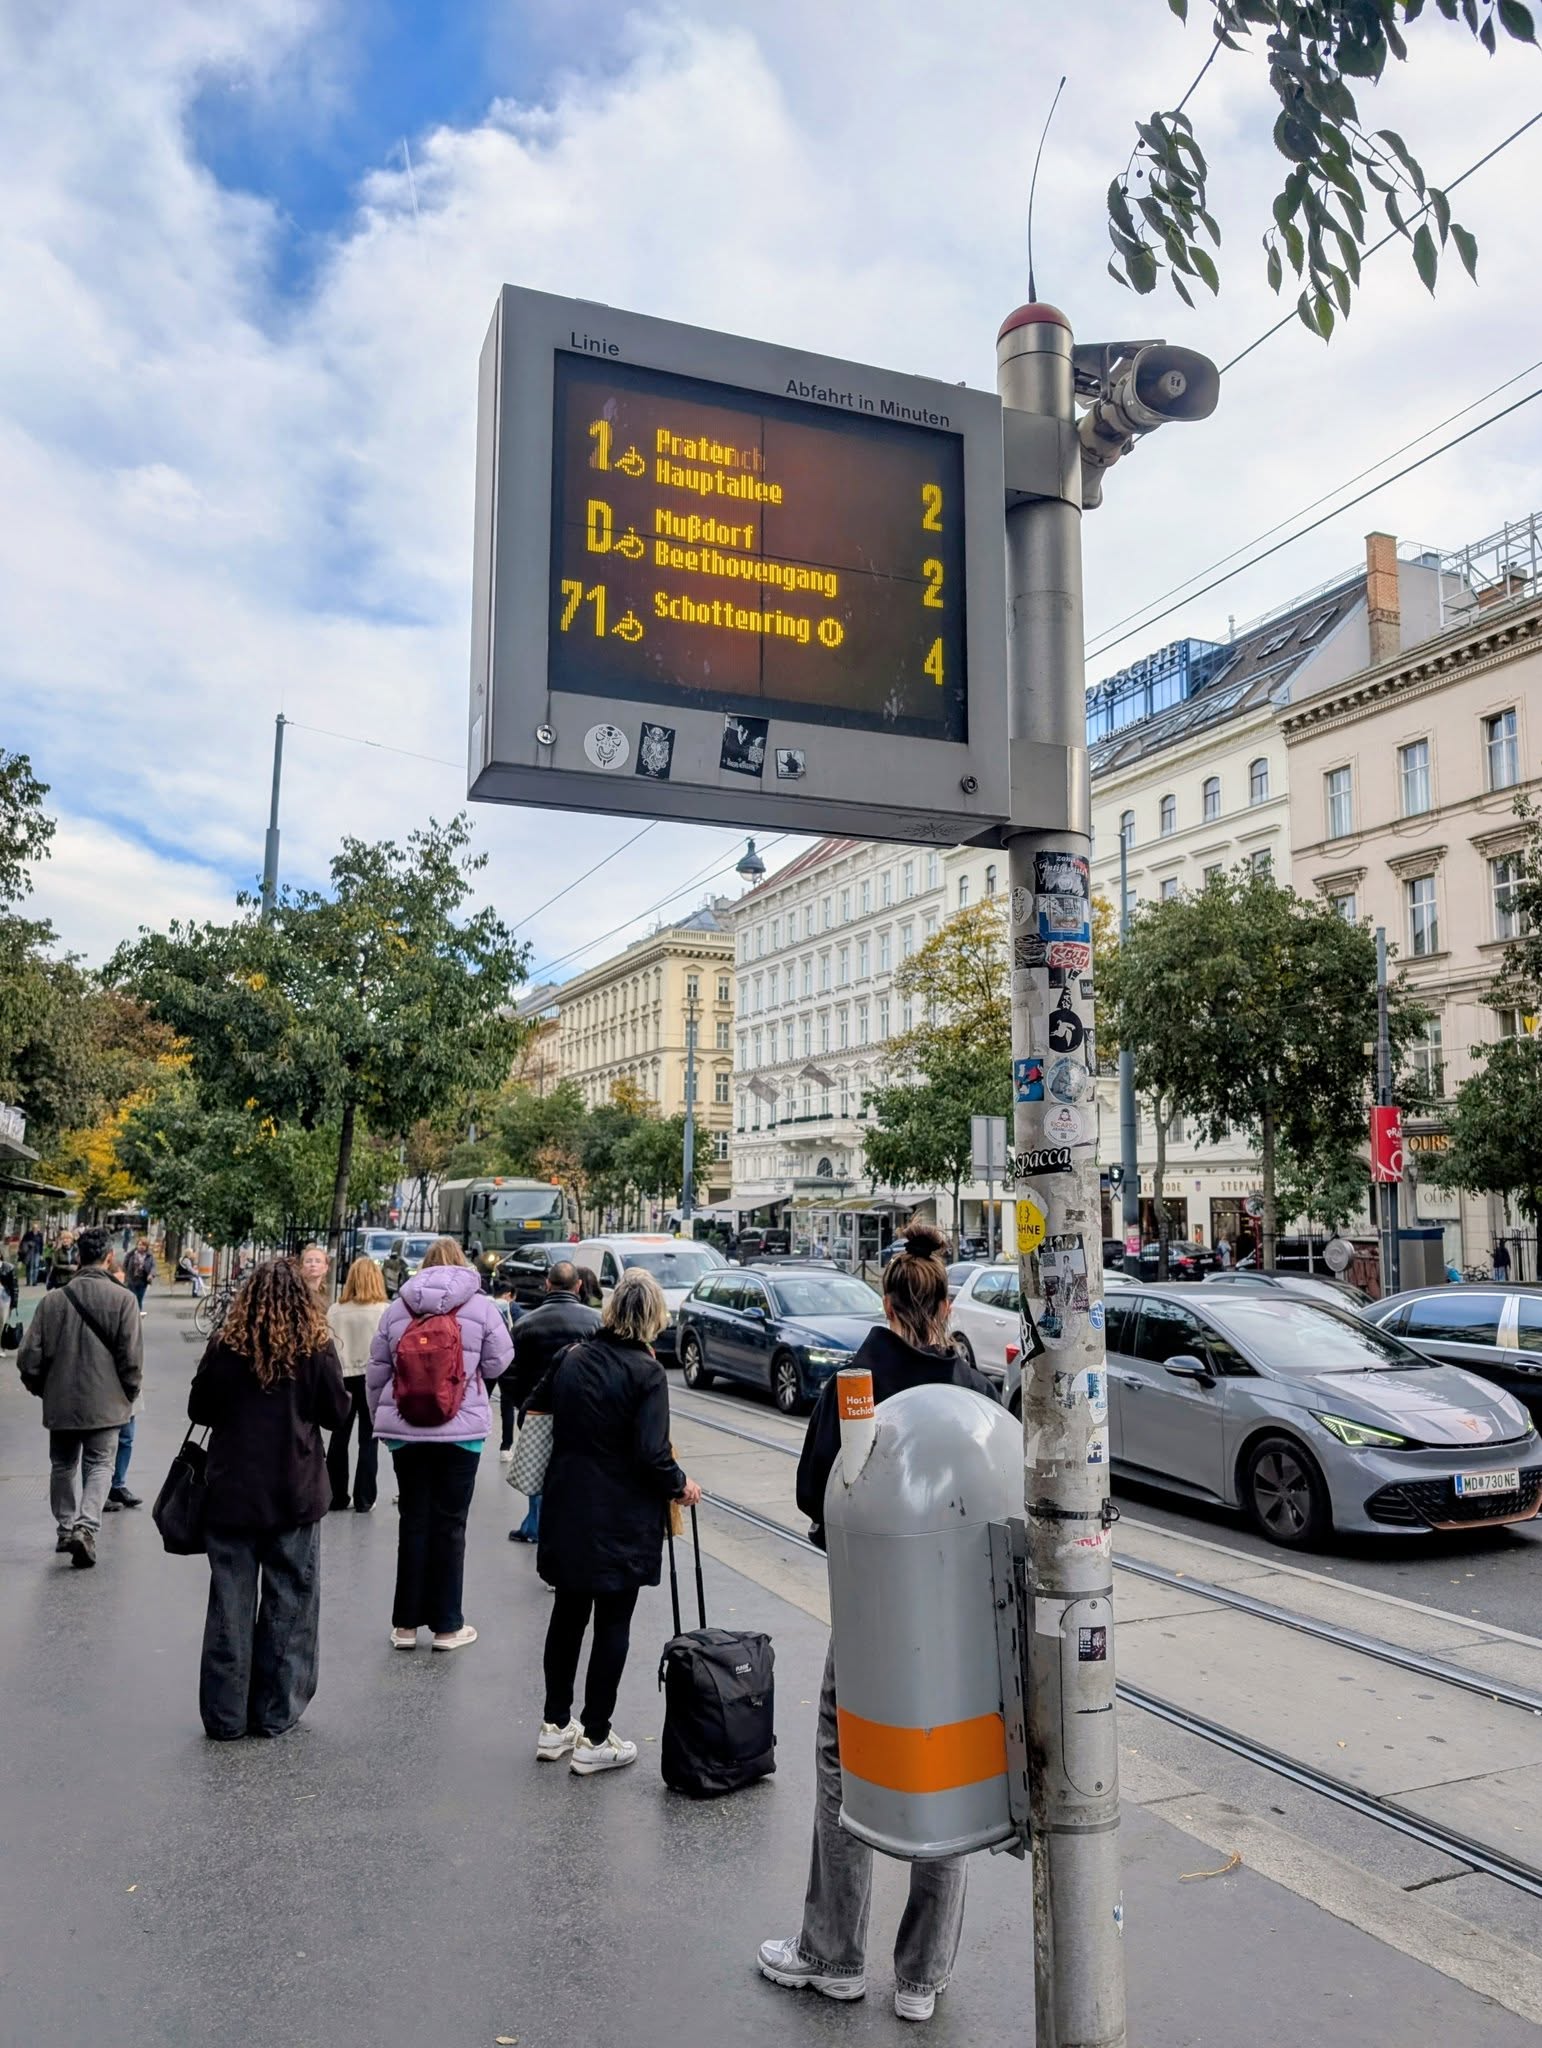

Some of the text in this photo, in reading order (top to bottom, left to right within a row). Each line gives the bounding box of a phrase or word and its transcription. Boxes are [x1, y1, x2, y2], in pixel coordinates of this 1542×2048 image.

[570, 331, 620, 357] Linie
[786, 379, 951, 428] Abfahrt in Minuten
[588, 420, 613, 470] 1
[656, 458, 783, 504] Hauptallee
[586, 499, 613, 553] D
[655, 508, 754, 549] Nußdorf
[921, 483, 943, 532] 2
[655, 540, 838, 598] Beethovengang
[922, 558, 944, 609] 2
[560, 579, 606, 637] 71
[654, 592, 810, 644] Schottenring
[923, 636, 944, 686] 4
[1464, 1478, 1478, 1491] MD
